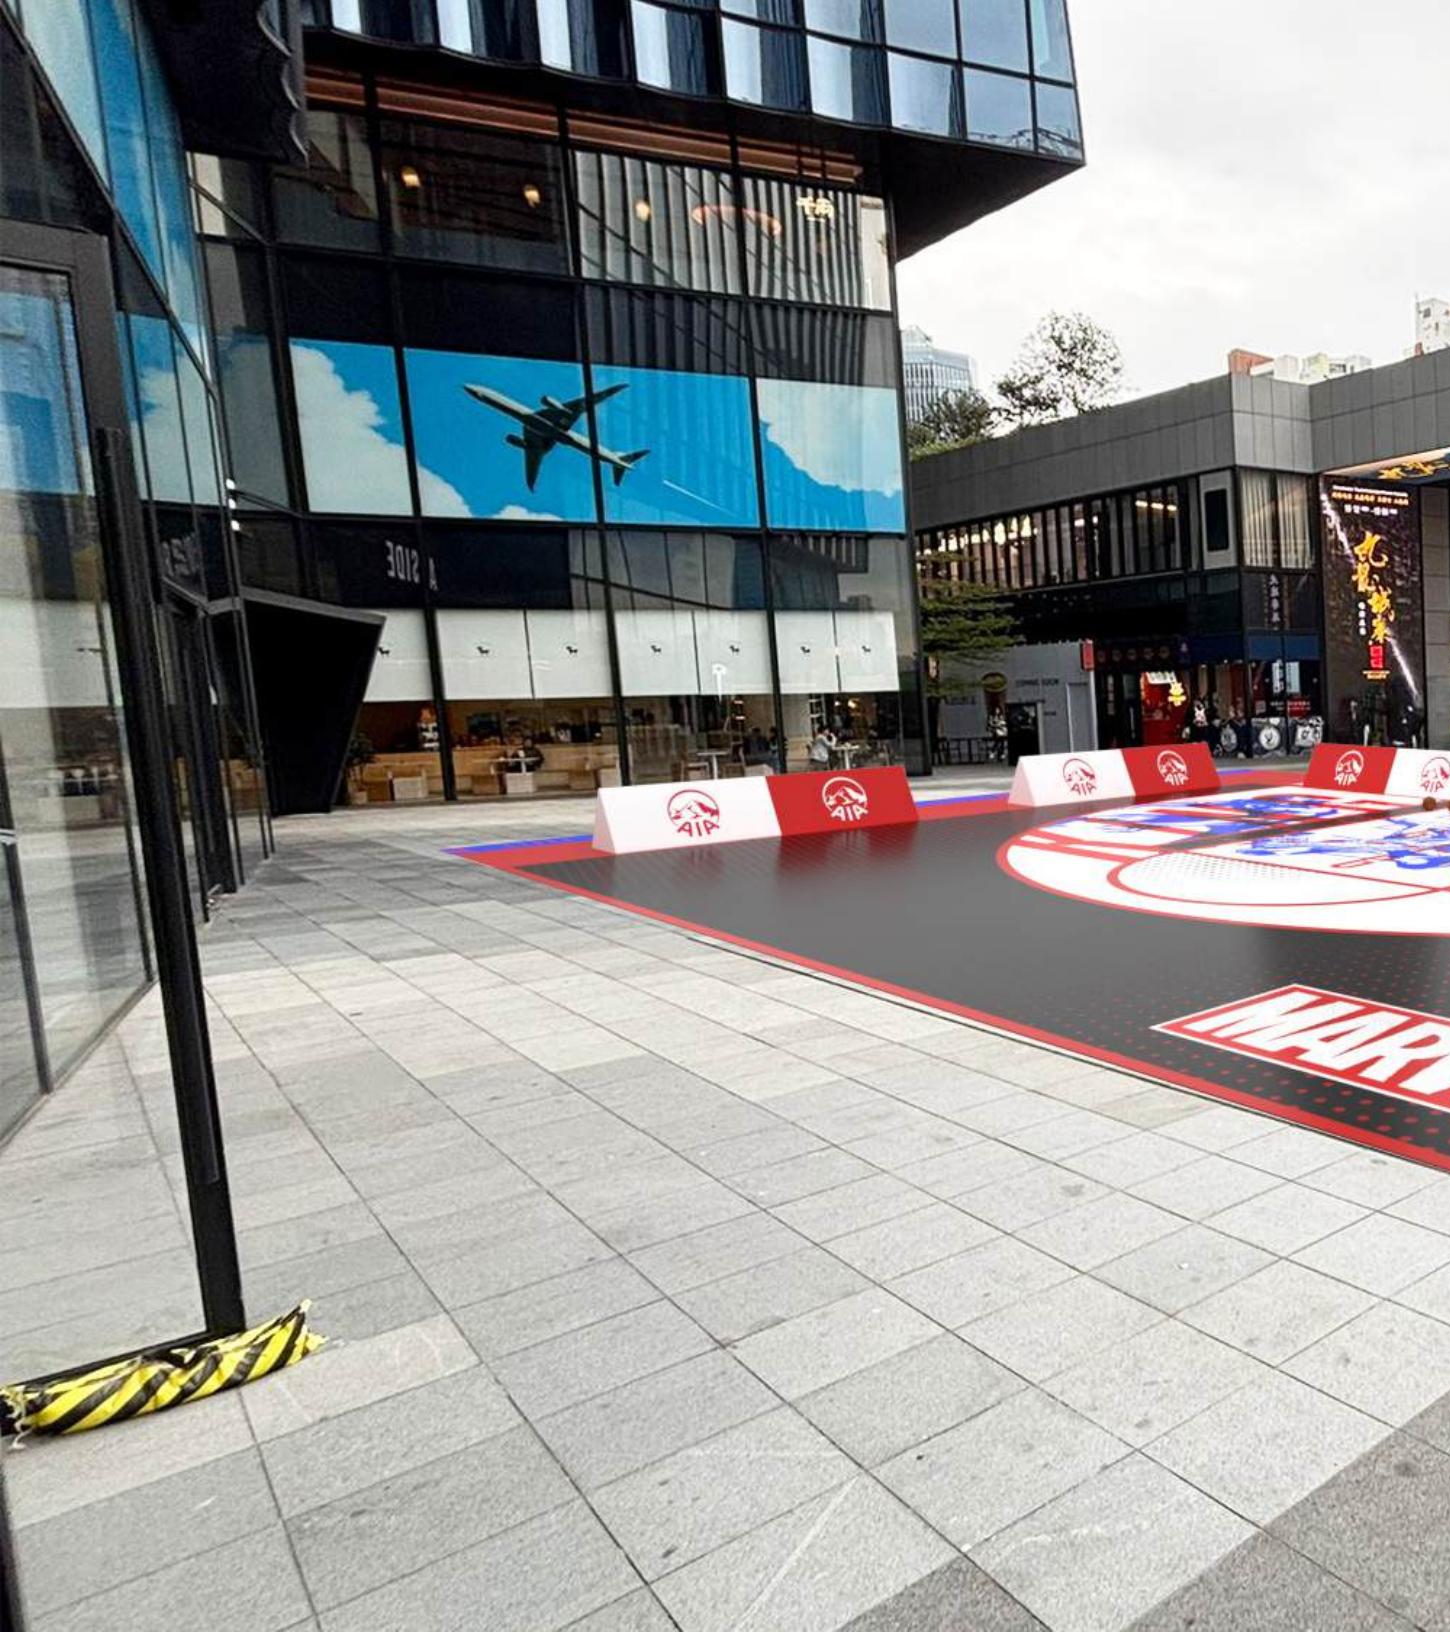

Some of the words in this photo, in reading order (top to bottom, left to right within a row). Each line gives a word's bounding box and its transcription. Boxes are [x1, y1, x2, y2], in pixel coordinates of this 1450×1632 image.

[1334, 772, 1358, 786] AIA
[831, 803, 869, 822] AIA
[676, 820, 720, 837] AIA
